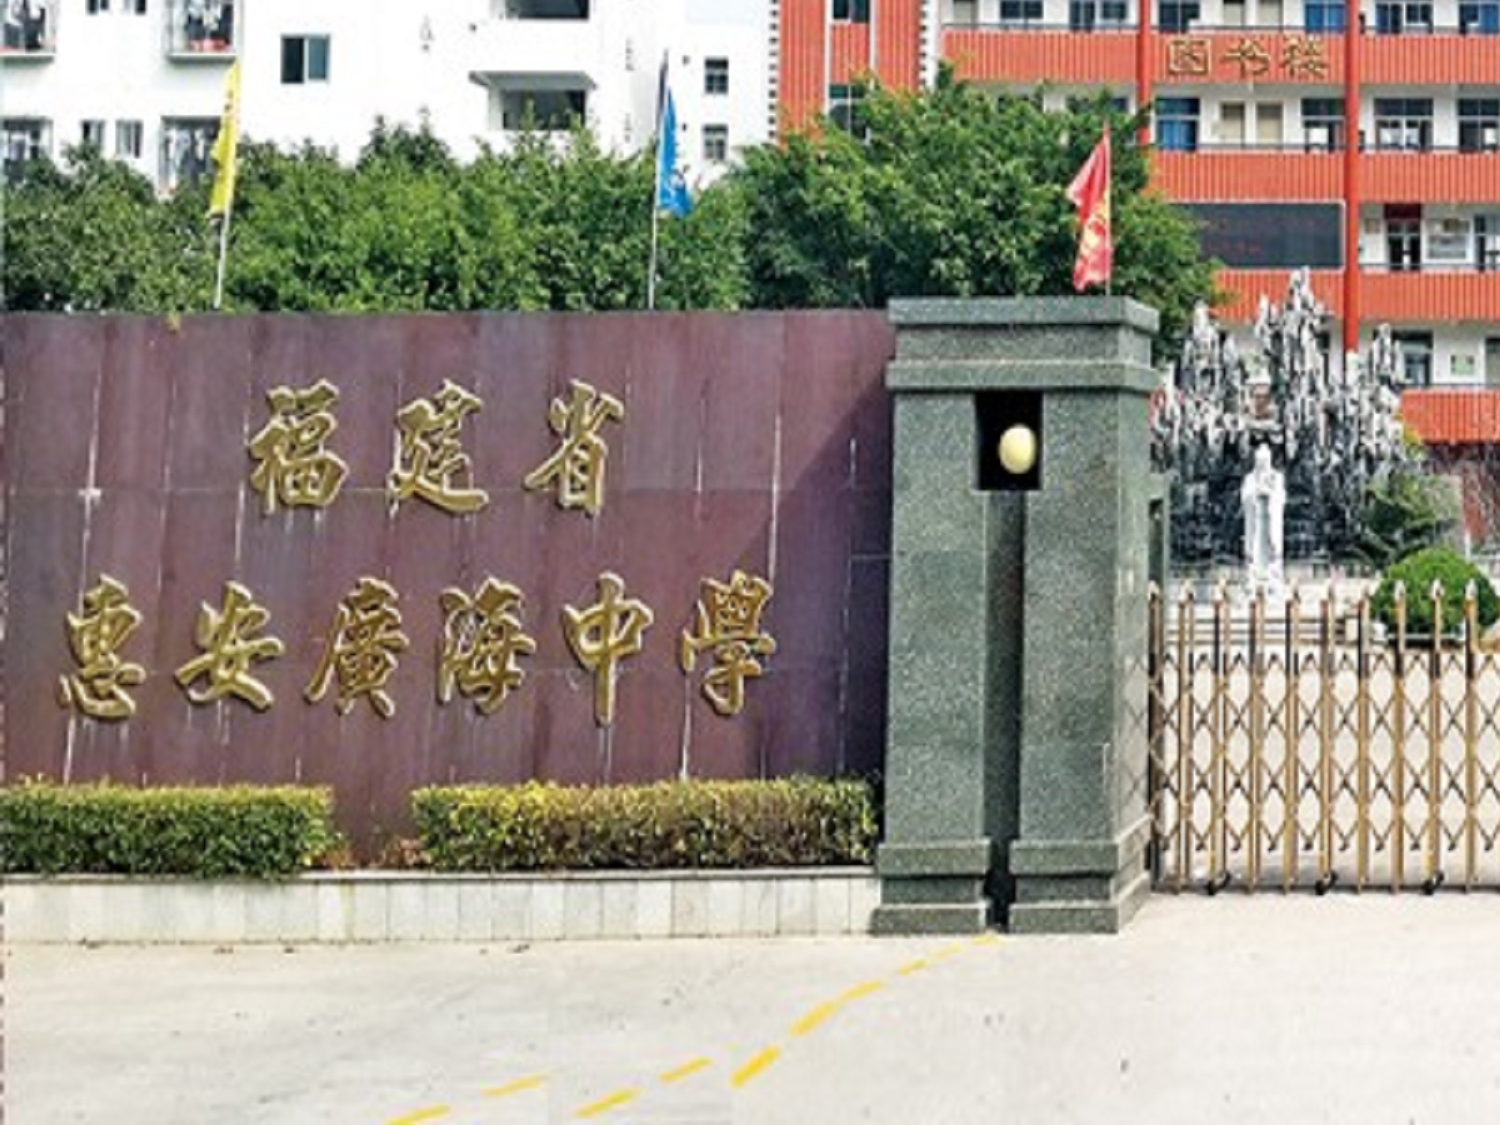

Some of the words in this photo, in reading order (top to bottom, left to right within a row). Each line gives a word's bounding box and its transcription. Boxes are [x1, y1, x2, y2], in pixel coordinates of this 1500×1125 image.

[1167, 35, 1330, 81] 图书楼
[247, 377, 626, 518] 福建省
[57, 570, 777, 726] 惠安廣海中學
